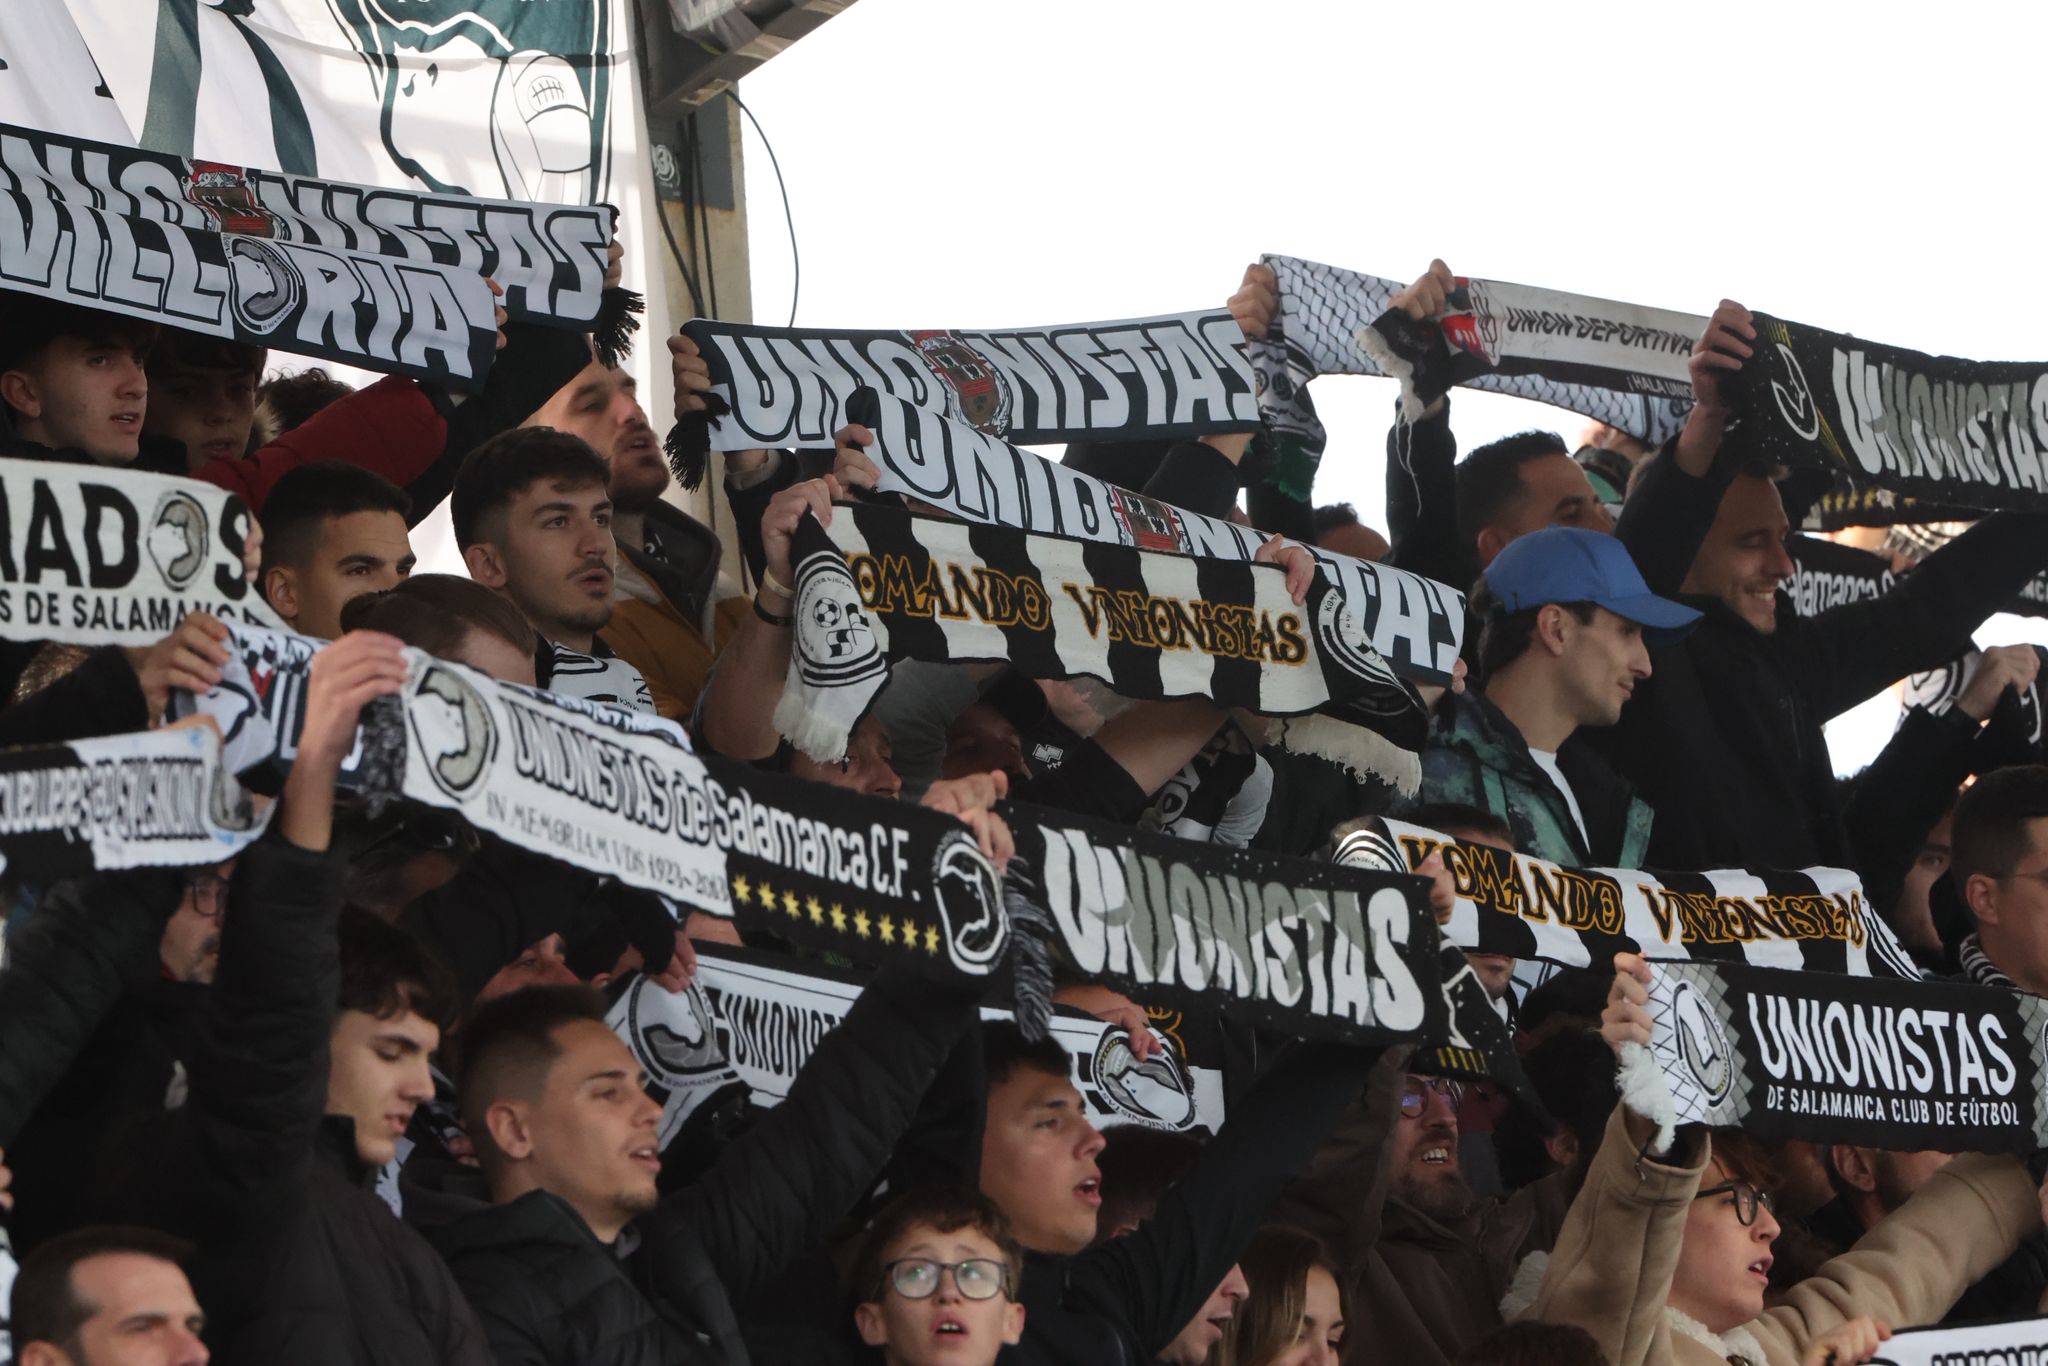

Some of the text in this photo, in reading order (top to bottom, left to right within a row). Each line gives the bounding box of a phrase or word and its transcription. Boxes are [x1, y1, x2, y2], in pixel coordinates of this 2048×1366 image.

[1506, 306, 1574, 338] UNION
[26, 591, 60, 626] DE
[847, 551, 1052, 631] OMANDO
[706, 776, 869, 890] Salamanca
[1038, 824, 1425, 1032] UNIONISTAS
[1748, 993, 2017, 1097] UNIONISTAS
[1767, 1085, 1784, 1111] DE
[1790, 1089, 1886, 1121] SALAMANCA
[1891, 1099, 1930, 1125] CLUB
[1936, 1101, 1953, 1125] DE
